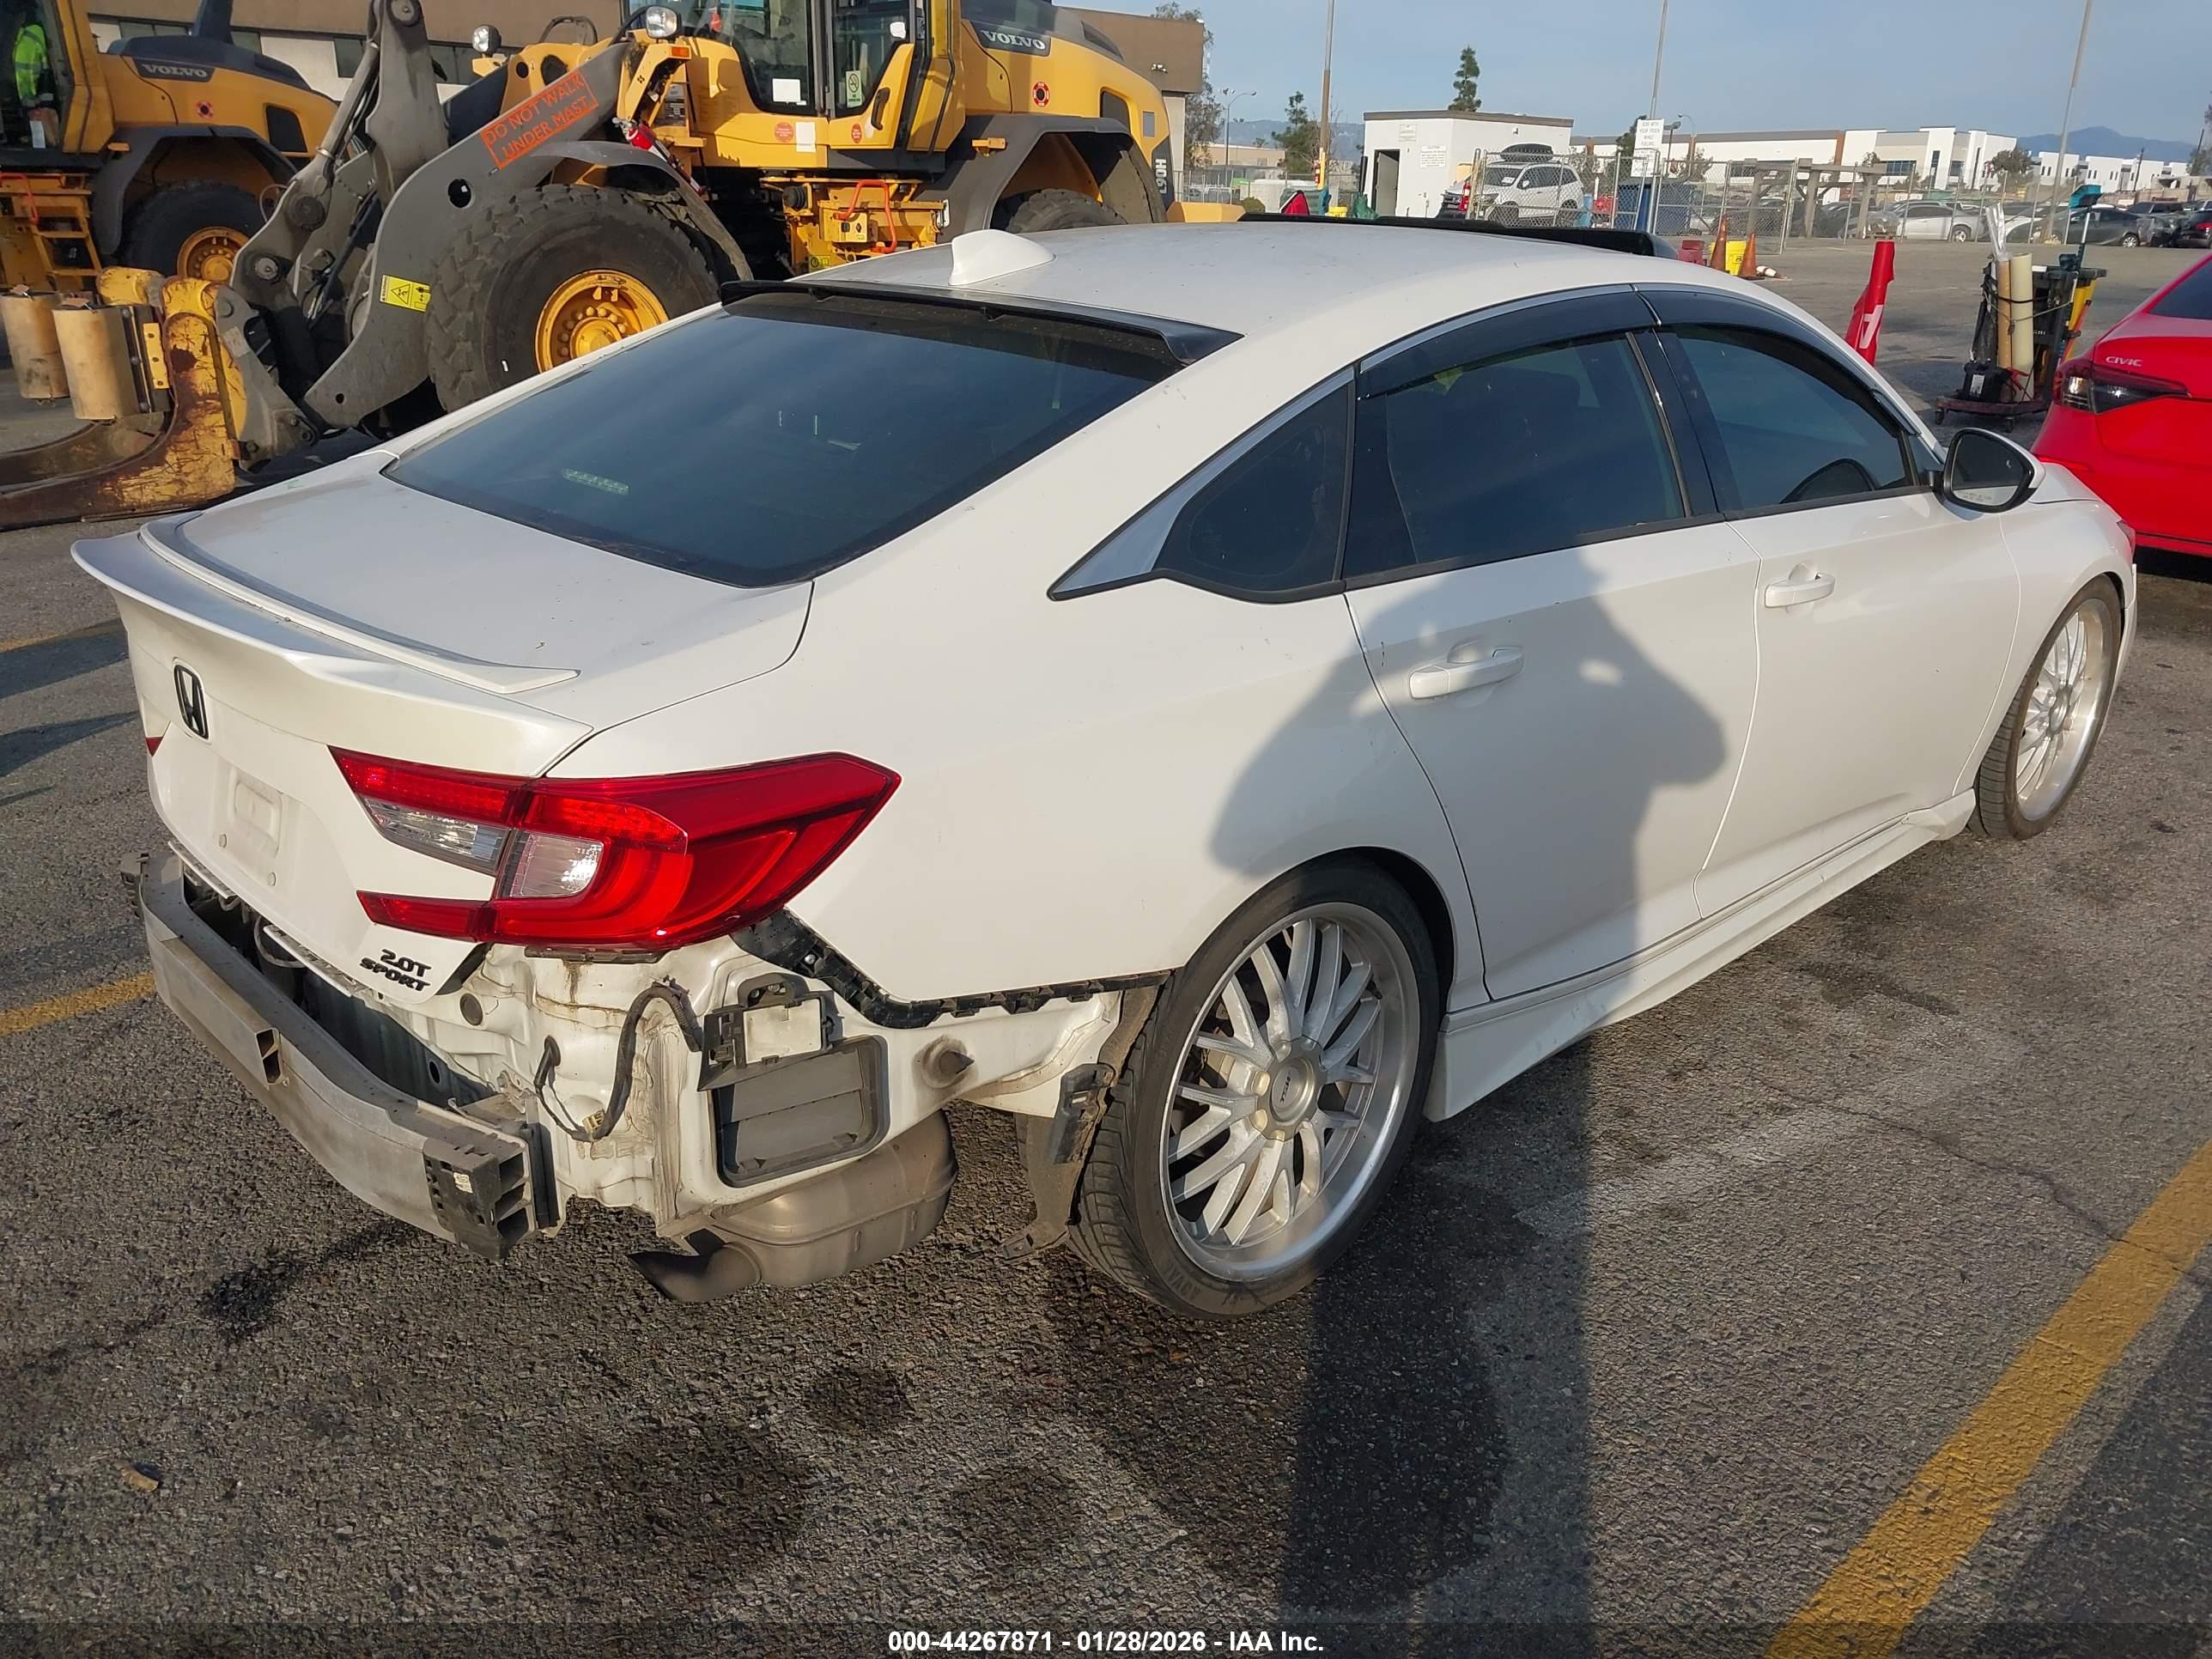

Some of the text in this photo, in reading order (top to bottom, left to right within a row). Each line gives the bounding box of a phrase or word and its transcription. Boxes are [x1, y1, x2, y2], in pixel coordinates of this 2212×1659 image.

[980, 29, 1046, 50] VOLVO
[141, 64, 208, 77] VOLVO
[486, 74, 585, 144] DO NOT WALK
[501, 95, 587, 155] UNDER MAST
[1155, 159, 1167, 194] L90H
[2106, 356, 2142, 368] CIVIC
[360, 957, 431, 991] SPORT
[380, 949, 432, 977] 2.0T
